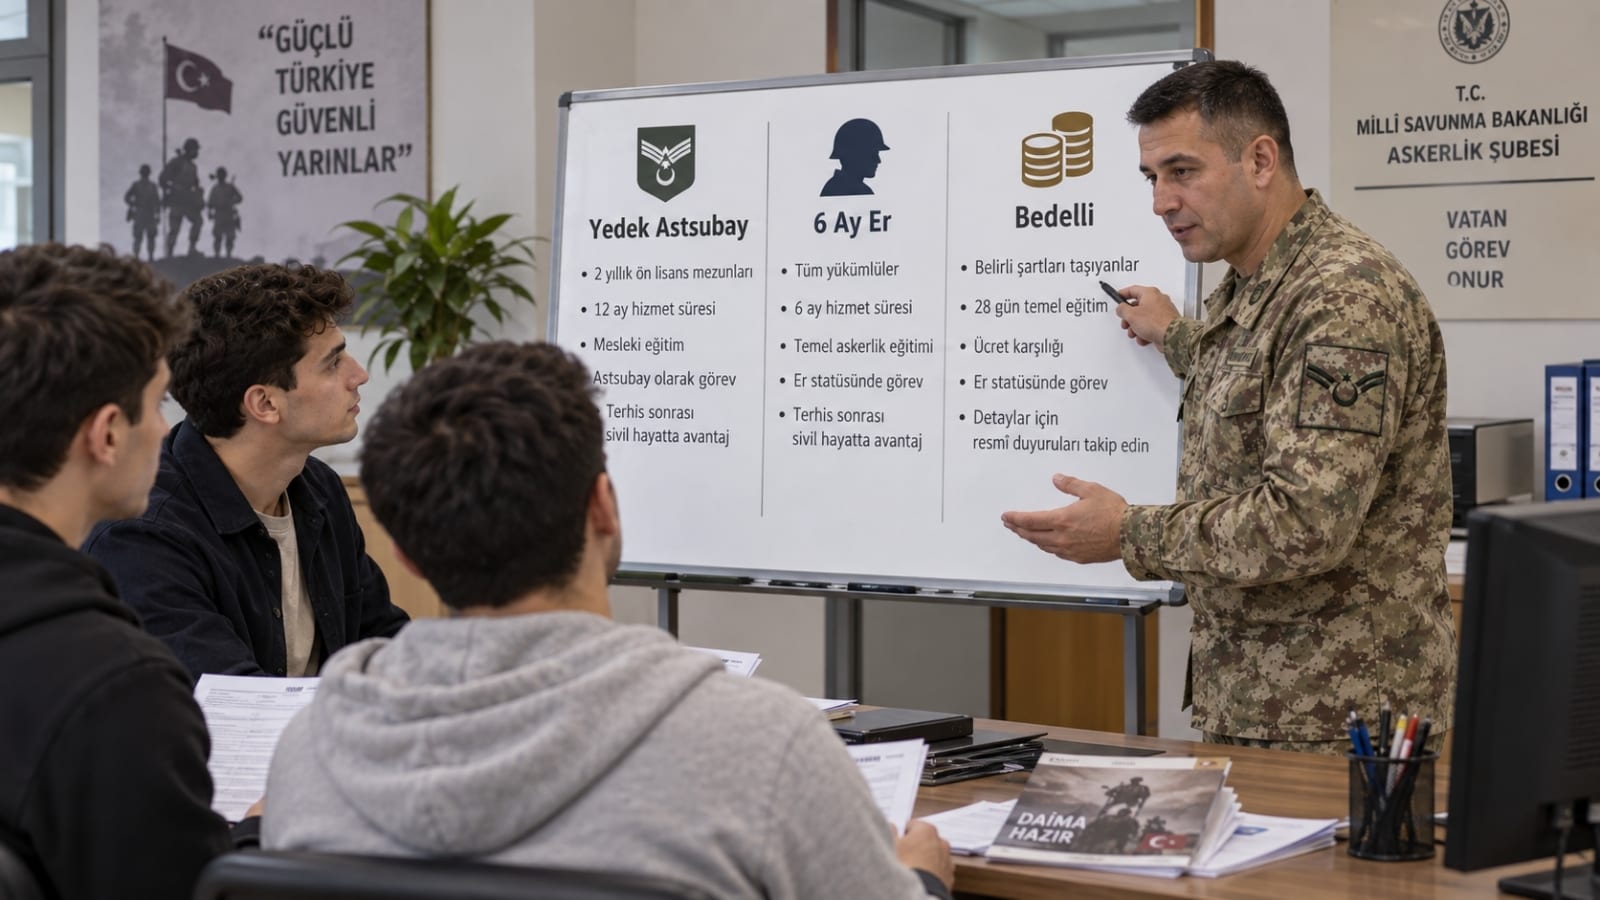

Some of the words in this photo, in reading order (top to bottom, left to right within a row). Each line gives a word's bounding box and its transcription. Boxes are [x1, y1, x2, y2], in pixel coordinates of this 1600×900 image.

[275, 58, 374, 94] TÜRKİYE
[1456, 85, 1485, 101] T.C.
[277, 98, 375, 136] GÜVENLİ
[1405, 113, 1486, 132] SAVUNMA
[1493, 103, 1587, 127] BAKANLIĞI
[1387, 139, 1482, 164] ASKERLİK
[1490, 134, 1559, 162] ŞUBESİ
[814, 212, 826, 233] 6
[834, 212, 861, 239] Ay
[870, 210, 891, 232] Er
[1016, 202, 1093, 228] Bedelli
[1447, 209, 1506, 228] VATAN
[589, 216, 649, 239] Yedek
[656, 214, 748, 240] Astsubay
[1446, 237, 1510, 259] GÖREV
[595, 267, 601, 280] 2
[606, 266, 632, 284] yıllık
[636, 267, 651, 279] ön
[656, 266, 689, 279] lisans
[693, 264, 752, 278] mezunları
[795, 264, 822, 277] Tüm
[827, 261, 899, 280] yükümlüler
[976, 259, 1012, 274] Belirli
[1018, 258, 1065, 277] şartları
[1070, 256, 1139, 276] taşıyanlar
[1448, 271, 1503, 288] ONUR
[595, 302, 609, 316] 12
[614, 305, 628, 320] ay
[633, 301, 674, 316] hizmet
[679, 301, 715, 315] süresi
[795, 301, 802, 315] 6
[807, 304, 822, 318] ay
[827, 300, 870, 314] hizmet
[875, 300, 912, 314] süresi
[975, 299, 991, 314] 28
[995, 300, 1019, 317] gün
[1024, 298, 1061, 313] temel
[1066, 298, 1107, 317] eğitim
[594, 337, 640, 351] Mesleki
[645, 337, 684, 355] eğitim
[794, 339, 832, 353] Temel
[837, 338, 885, 353] askerlik
[890, 339, 933, 357] eğitimi
[975, 336, 1009, 353] Ücret
[1014, 338, 1063, 357] karşılığı
[593, 370, 651, 389] Astsubay
[655, 371, 694, 385] olarak
[699, 372, 736, 389] görev
[795, 373, 807, 387] Er
[811, 373, 882, 388] statüsünde
[887, 374, 923, 392] görev
[975, 375, 987, 389] Er
[992, 375, 1065, 389] statüsünde
[1070, 375, 1108, 393] görev
[607, 404, 644, 418] Terhis
[649, 408, 693, 419] sonrası
[793, 407, 833, 422] Terhis
[837, 411, 884, 423] sonrası
[974, 410, 1031, 428] Detaylar
[1036, 410, 1058, 429] için
[606, 427, 629, 442] sivil
[633, 428, 679, 445] hayatta
[683, 430, 729, 447] avantaj
[793, 431, 816, 445] sivil
[822, 431, 870, 450] hayatta
[875, 433, 922, 452] avantaj
[1013, 435, 1079, 454] duyuruları
[1084, 437, 1117, 456] takip
[1121, 437, 1149, 452] edin
[1018, 812, 1086, 829] DAİMA
[1008, 827, 1074, 844] HAZIR
